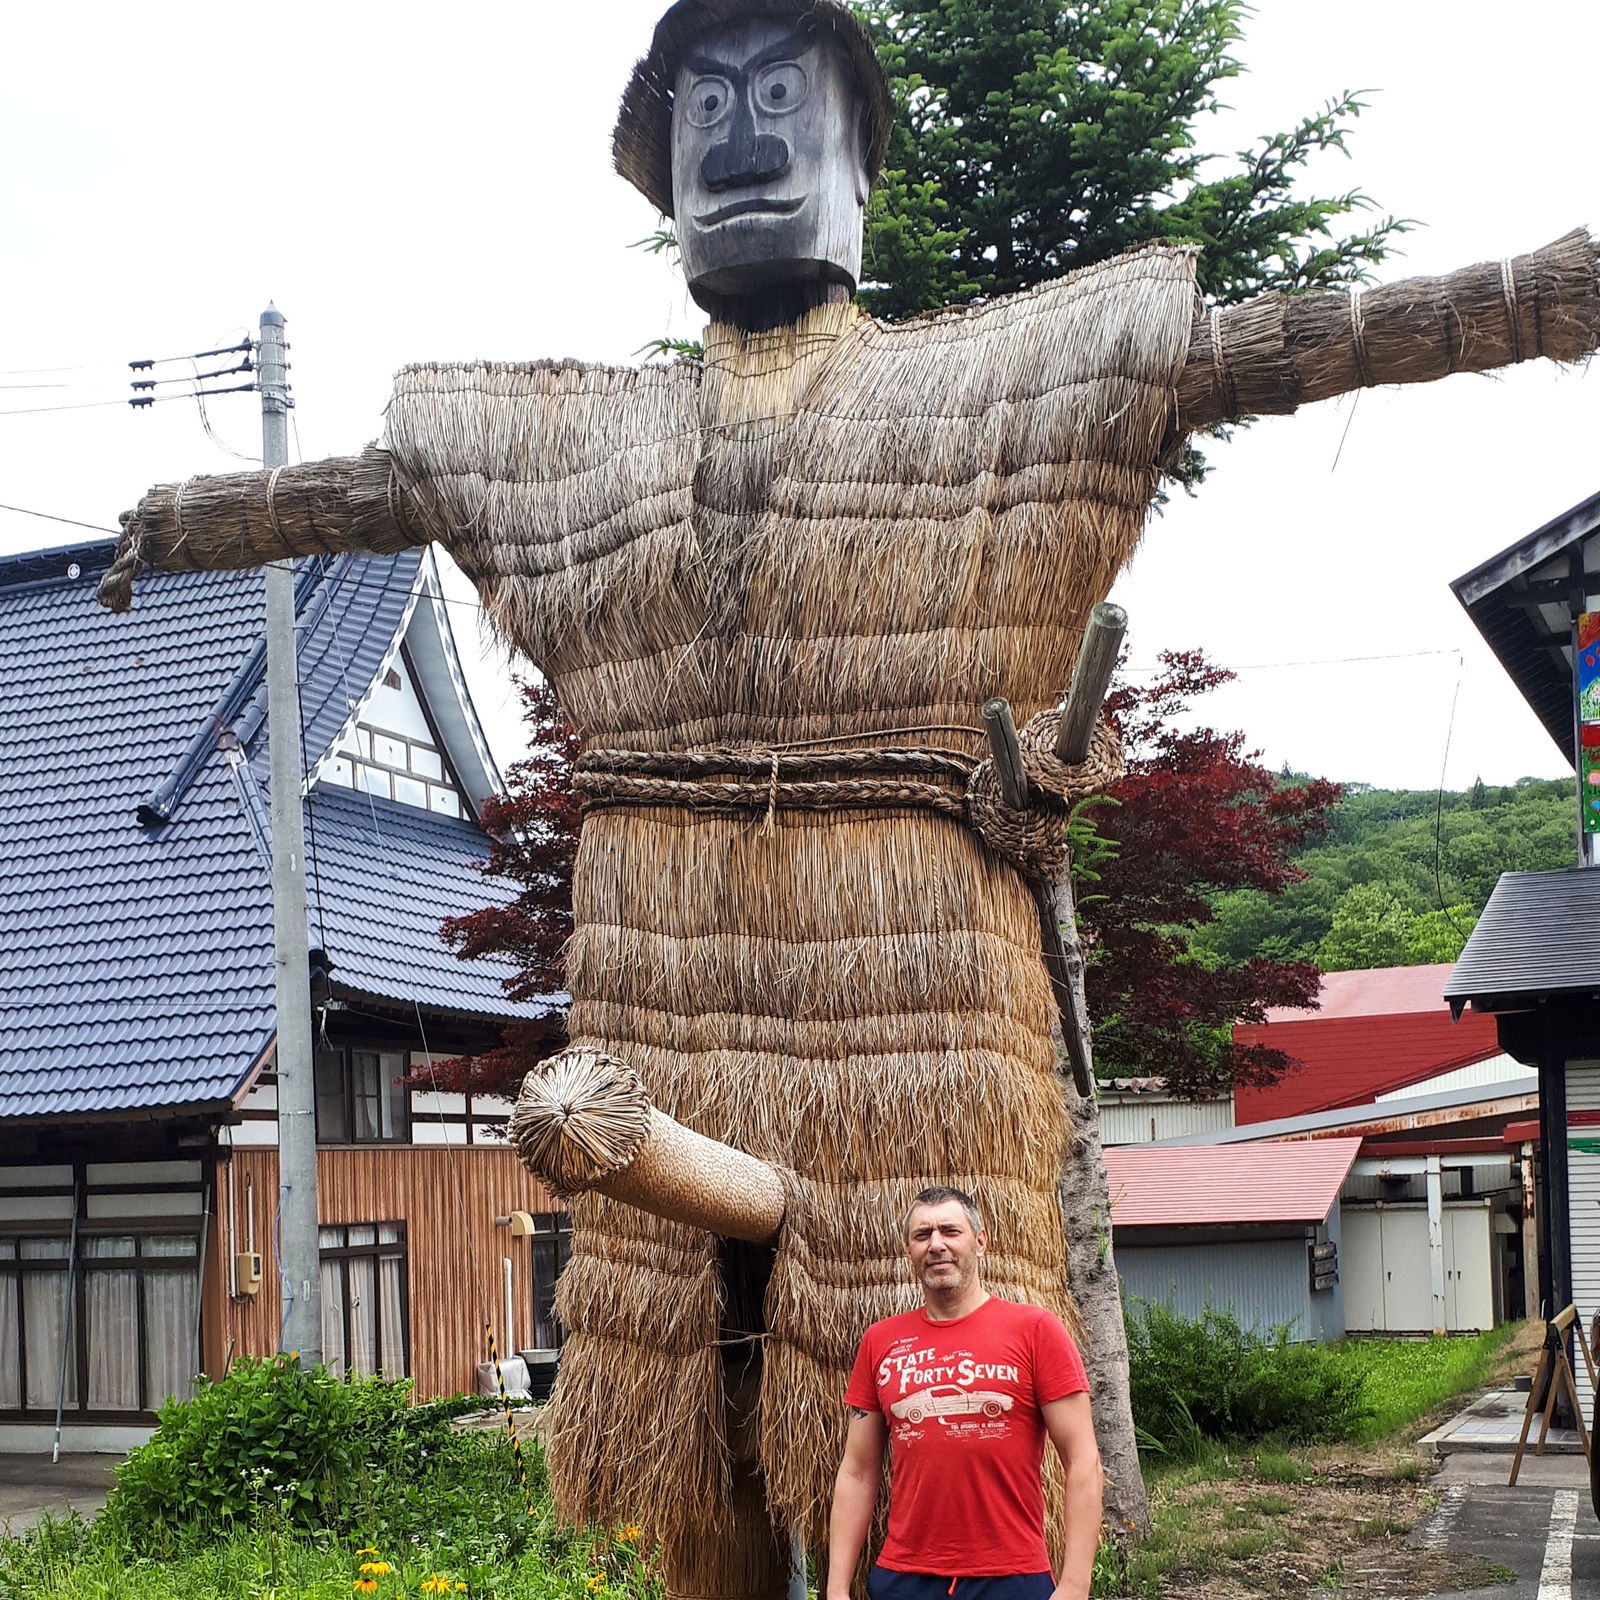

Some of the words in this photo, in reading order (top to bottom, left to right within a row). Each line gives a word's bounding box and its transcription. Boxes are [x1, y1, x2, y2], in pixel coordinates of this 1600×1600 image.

[878, 1348, 935, 1386] STATE
[899, 1366, 956, 1394] FORTY
[956, 1359, 1019, 1386] SEVEN
